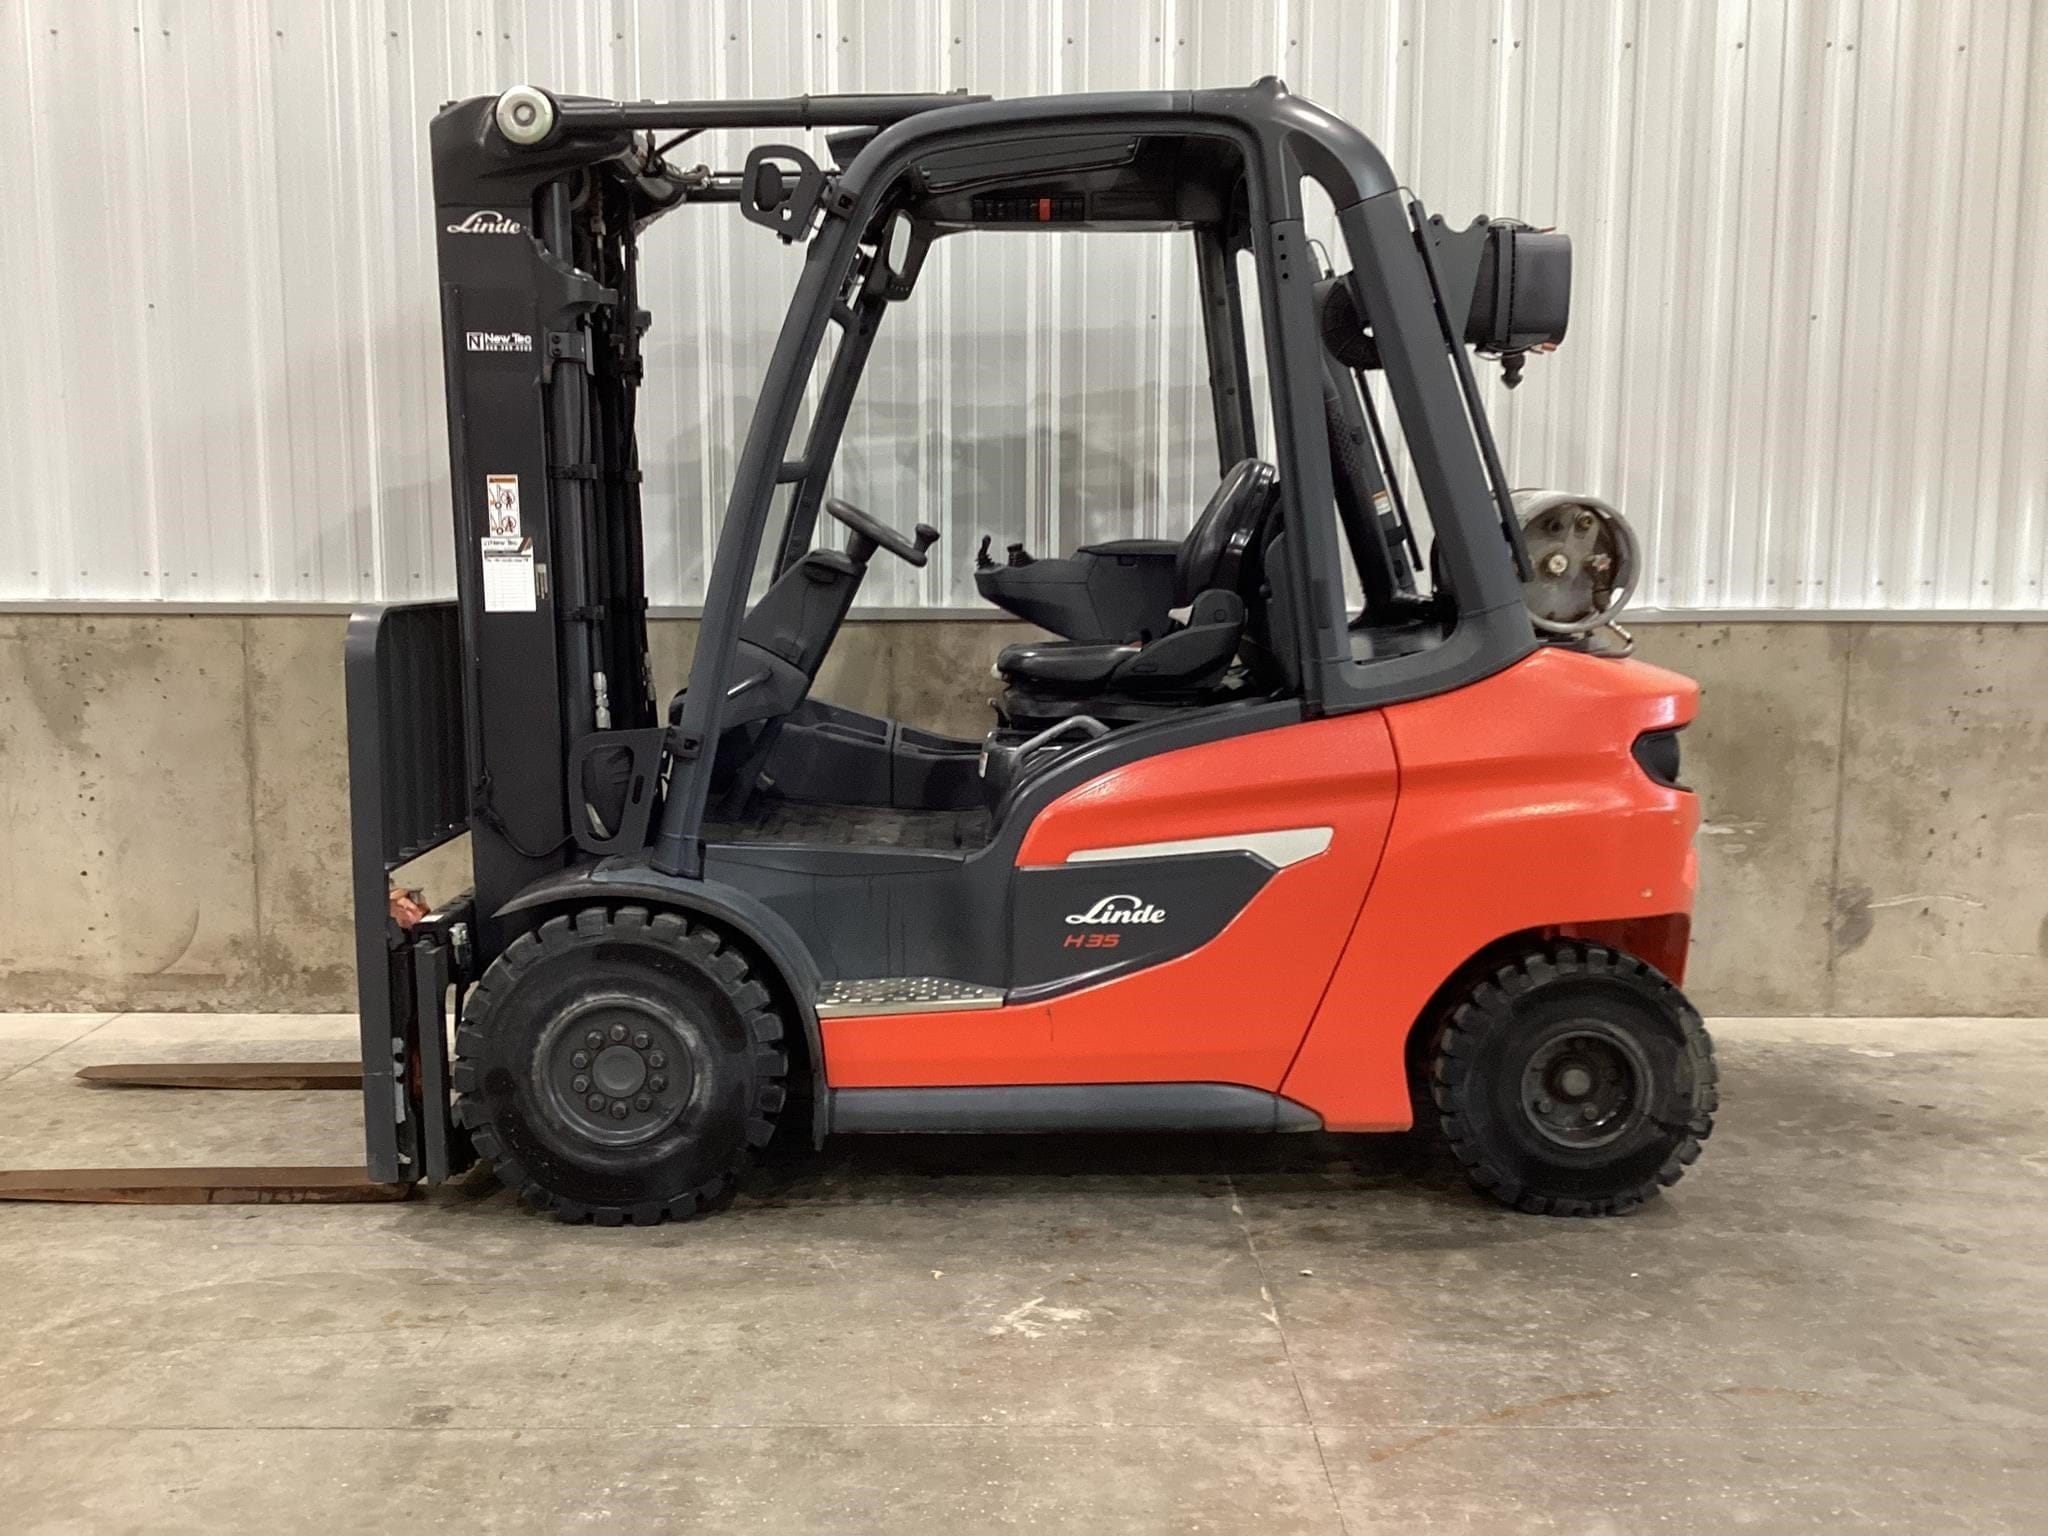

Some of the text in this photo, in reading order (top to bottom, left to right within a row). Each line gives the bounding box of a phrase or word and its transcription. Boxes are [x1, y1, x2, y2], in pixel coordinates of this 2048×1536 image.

[447, 210, 520, 234] Linde
[485, 333, 510, 344] New
[1065, 894, 1166, 924] Linde
